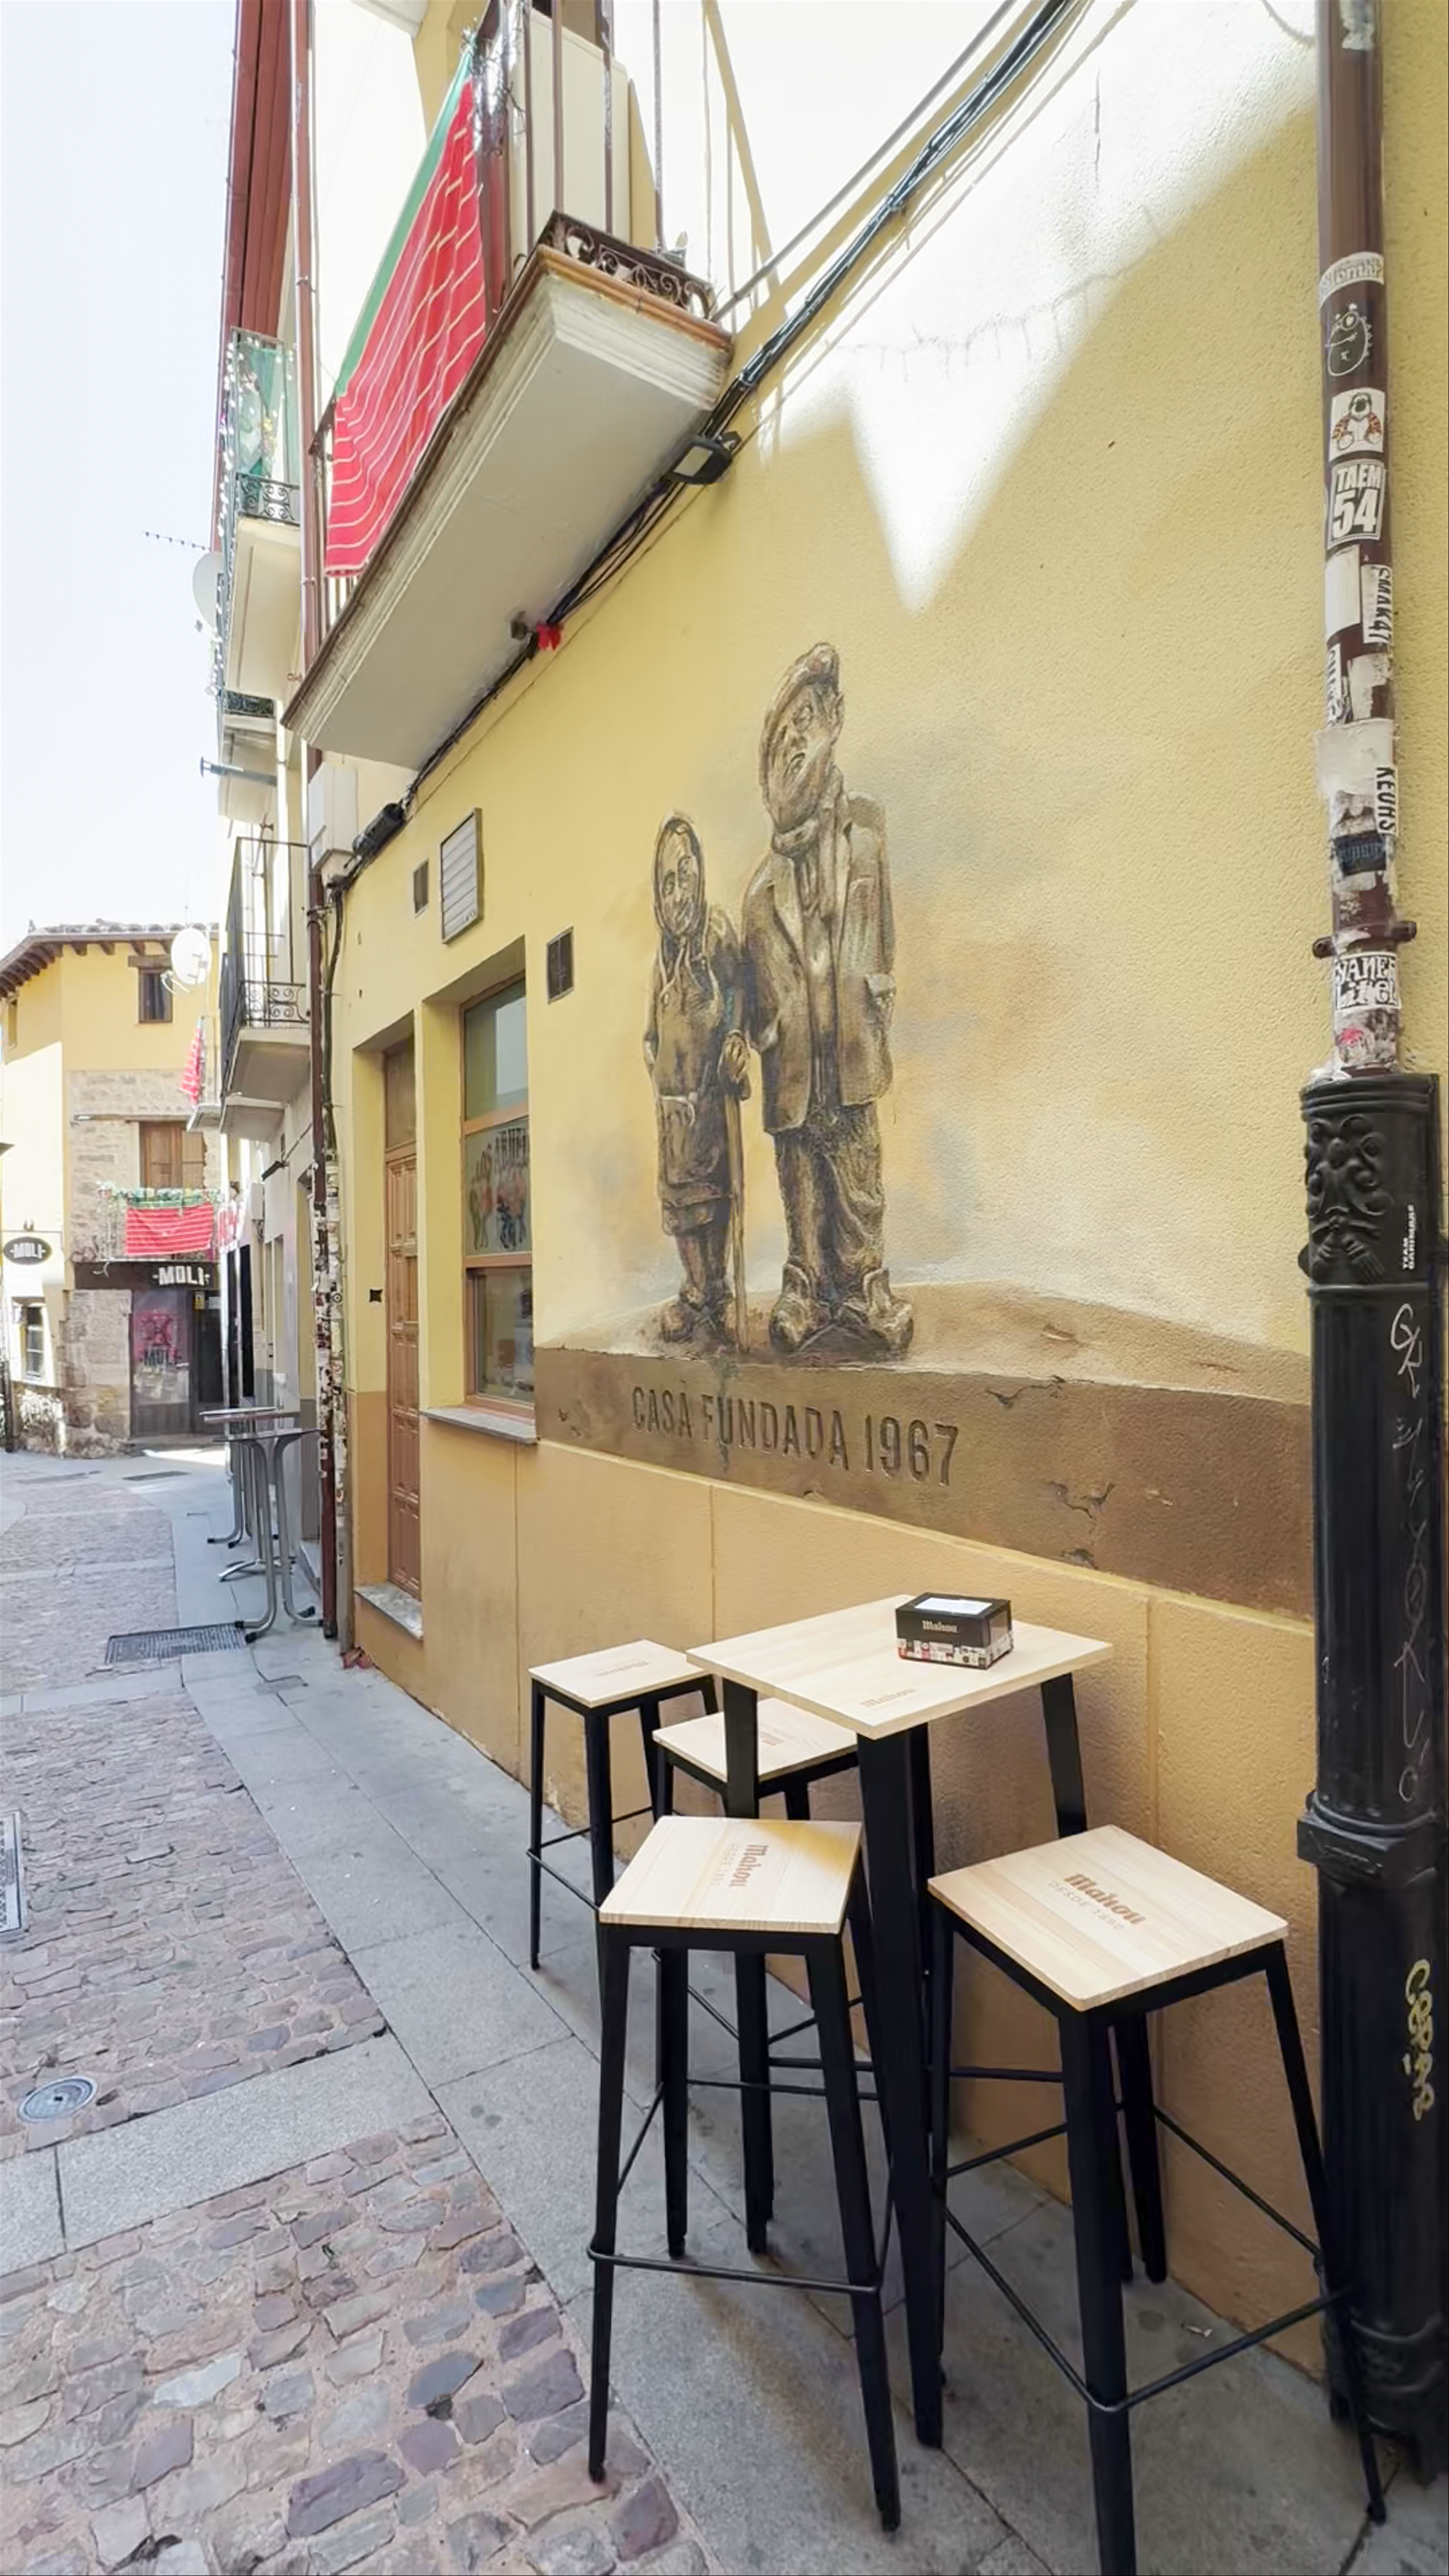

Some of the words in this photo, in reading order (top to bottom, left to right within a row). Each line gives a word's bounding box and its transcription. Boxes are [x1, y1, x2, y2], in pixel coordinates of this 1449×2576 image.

[1336, 464, 1382, 491] TAEM
[1333, 489, 1378, 537] 54
[14, 1243, 43, 1258] MOLI
[158, 1266, 205, 1285] MOLI
[633, 1387, 692, 1438] CASA
[701, 1394, 849, 1471] FUNDADA
[865, 1415, 958, 1486] 1967
[728, 1845, 769, 1887] Mahou
[1063, 1874, 1146, 1924] Mahou
